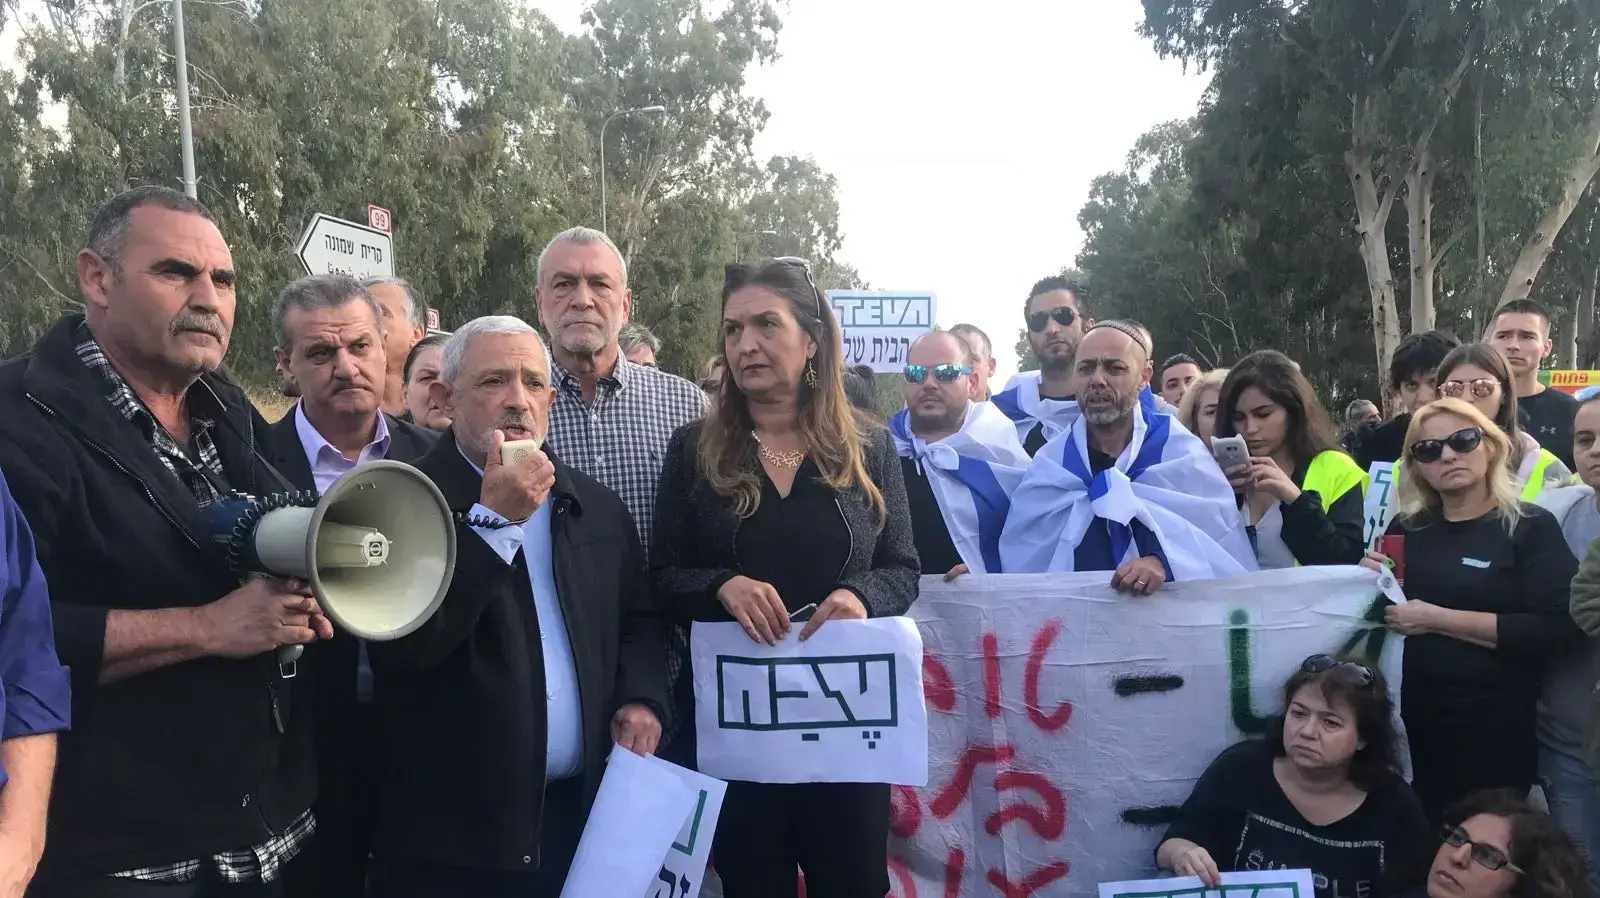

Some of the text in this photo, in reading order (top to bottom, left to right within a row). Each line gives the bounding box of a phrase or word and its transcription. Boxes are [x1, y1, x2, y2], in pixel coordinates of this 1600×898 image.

[374, 212, 386, 227] 99
[325, 234, 383, 265] קרית שמונה
[832, 297, 931, 327] TEVA
